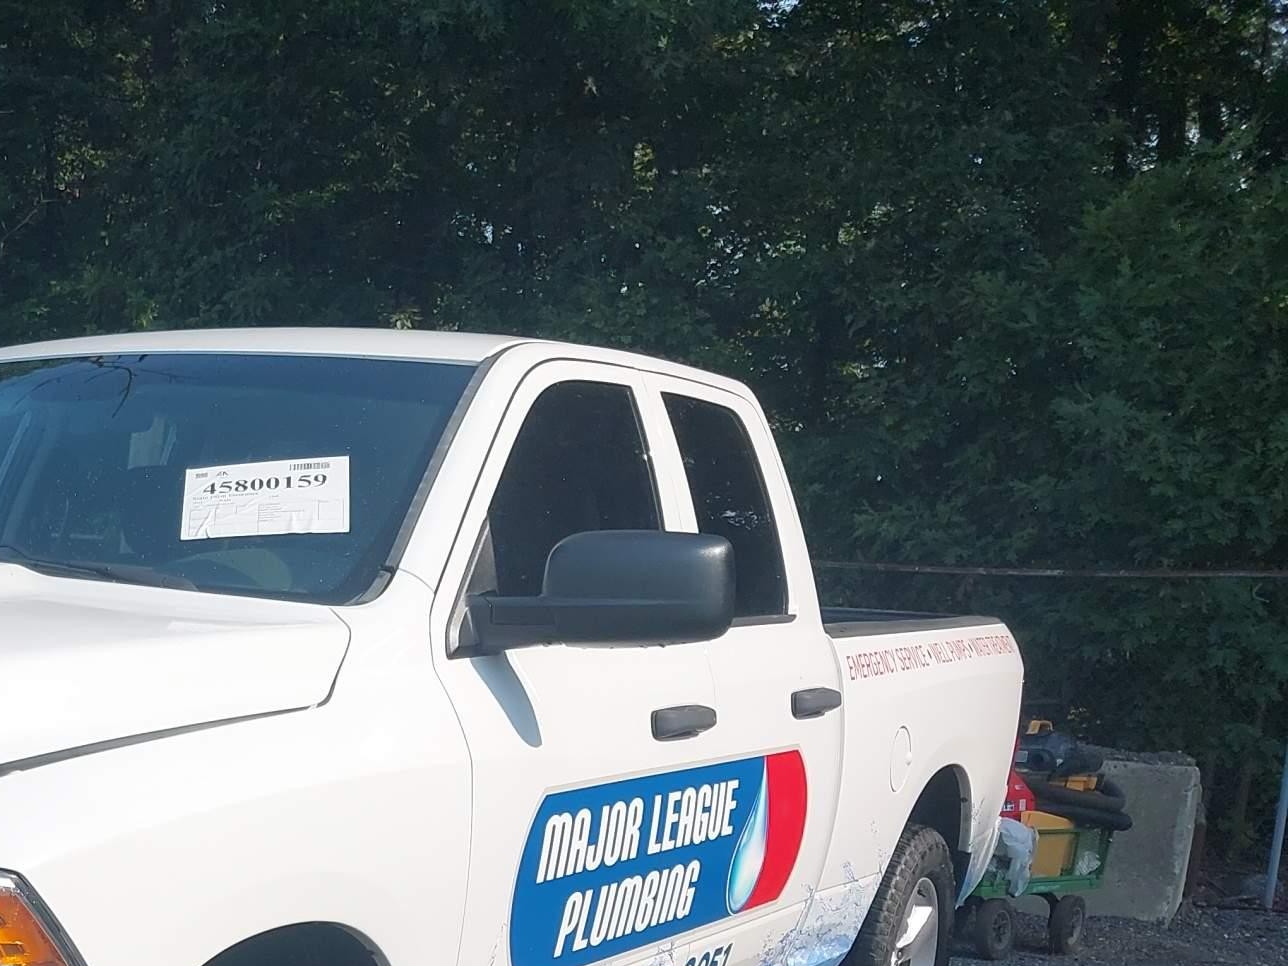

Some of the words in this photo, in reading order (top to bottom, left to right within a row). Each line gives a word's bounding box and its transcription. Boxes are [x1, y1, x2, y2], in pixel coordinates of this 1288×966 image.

[203, 474, 328, 495] 45800159
[847, 649, 898, 680] EMERGENCY
[895, 645, 930, 671] SERVICE
[536, 797, 645, 884] MAJOR
[647, 779, 740, 855] LEAGUE
[553, 860, 701, 959] PLUMBING
